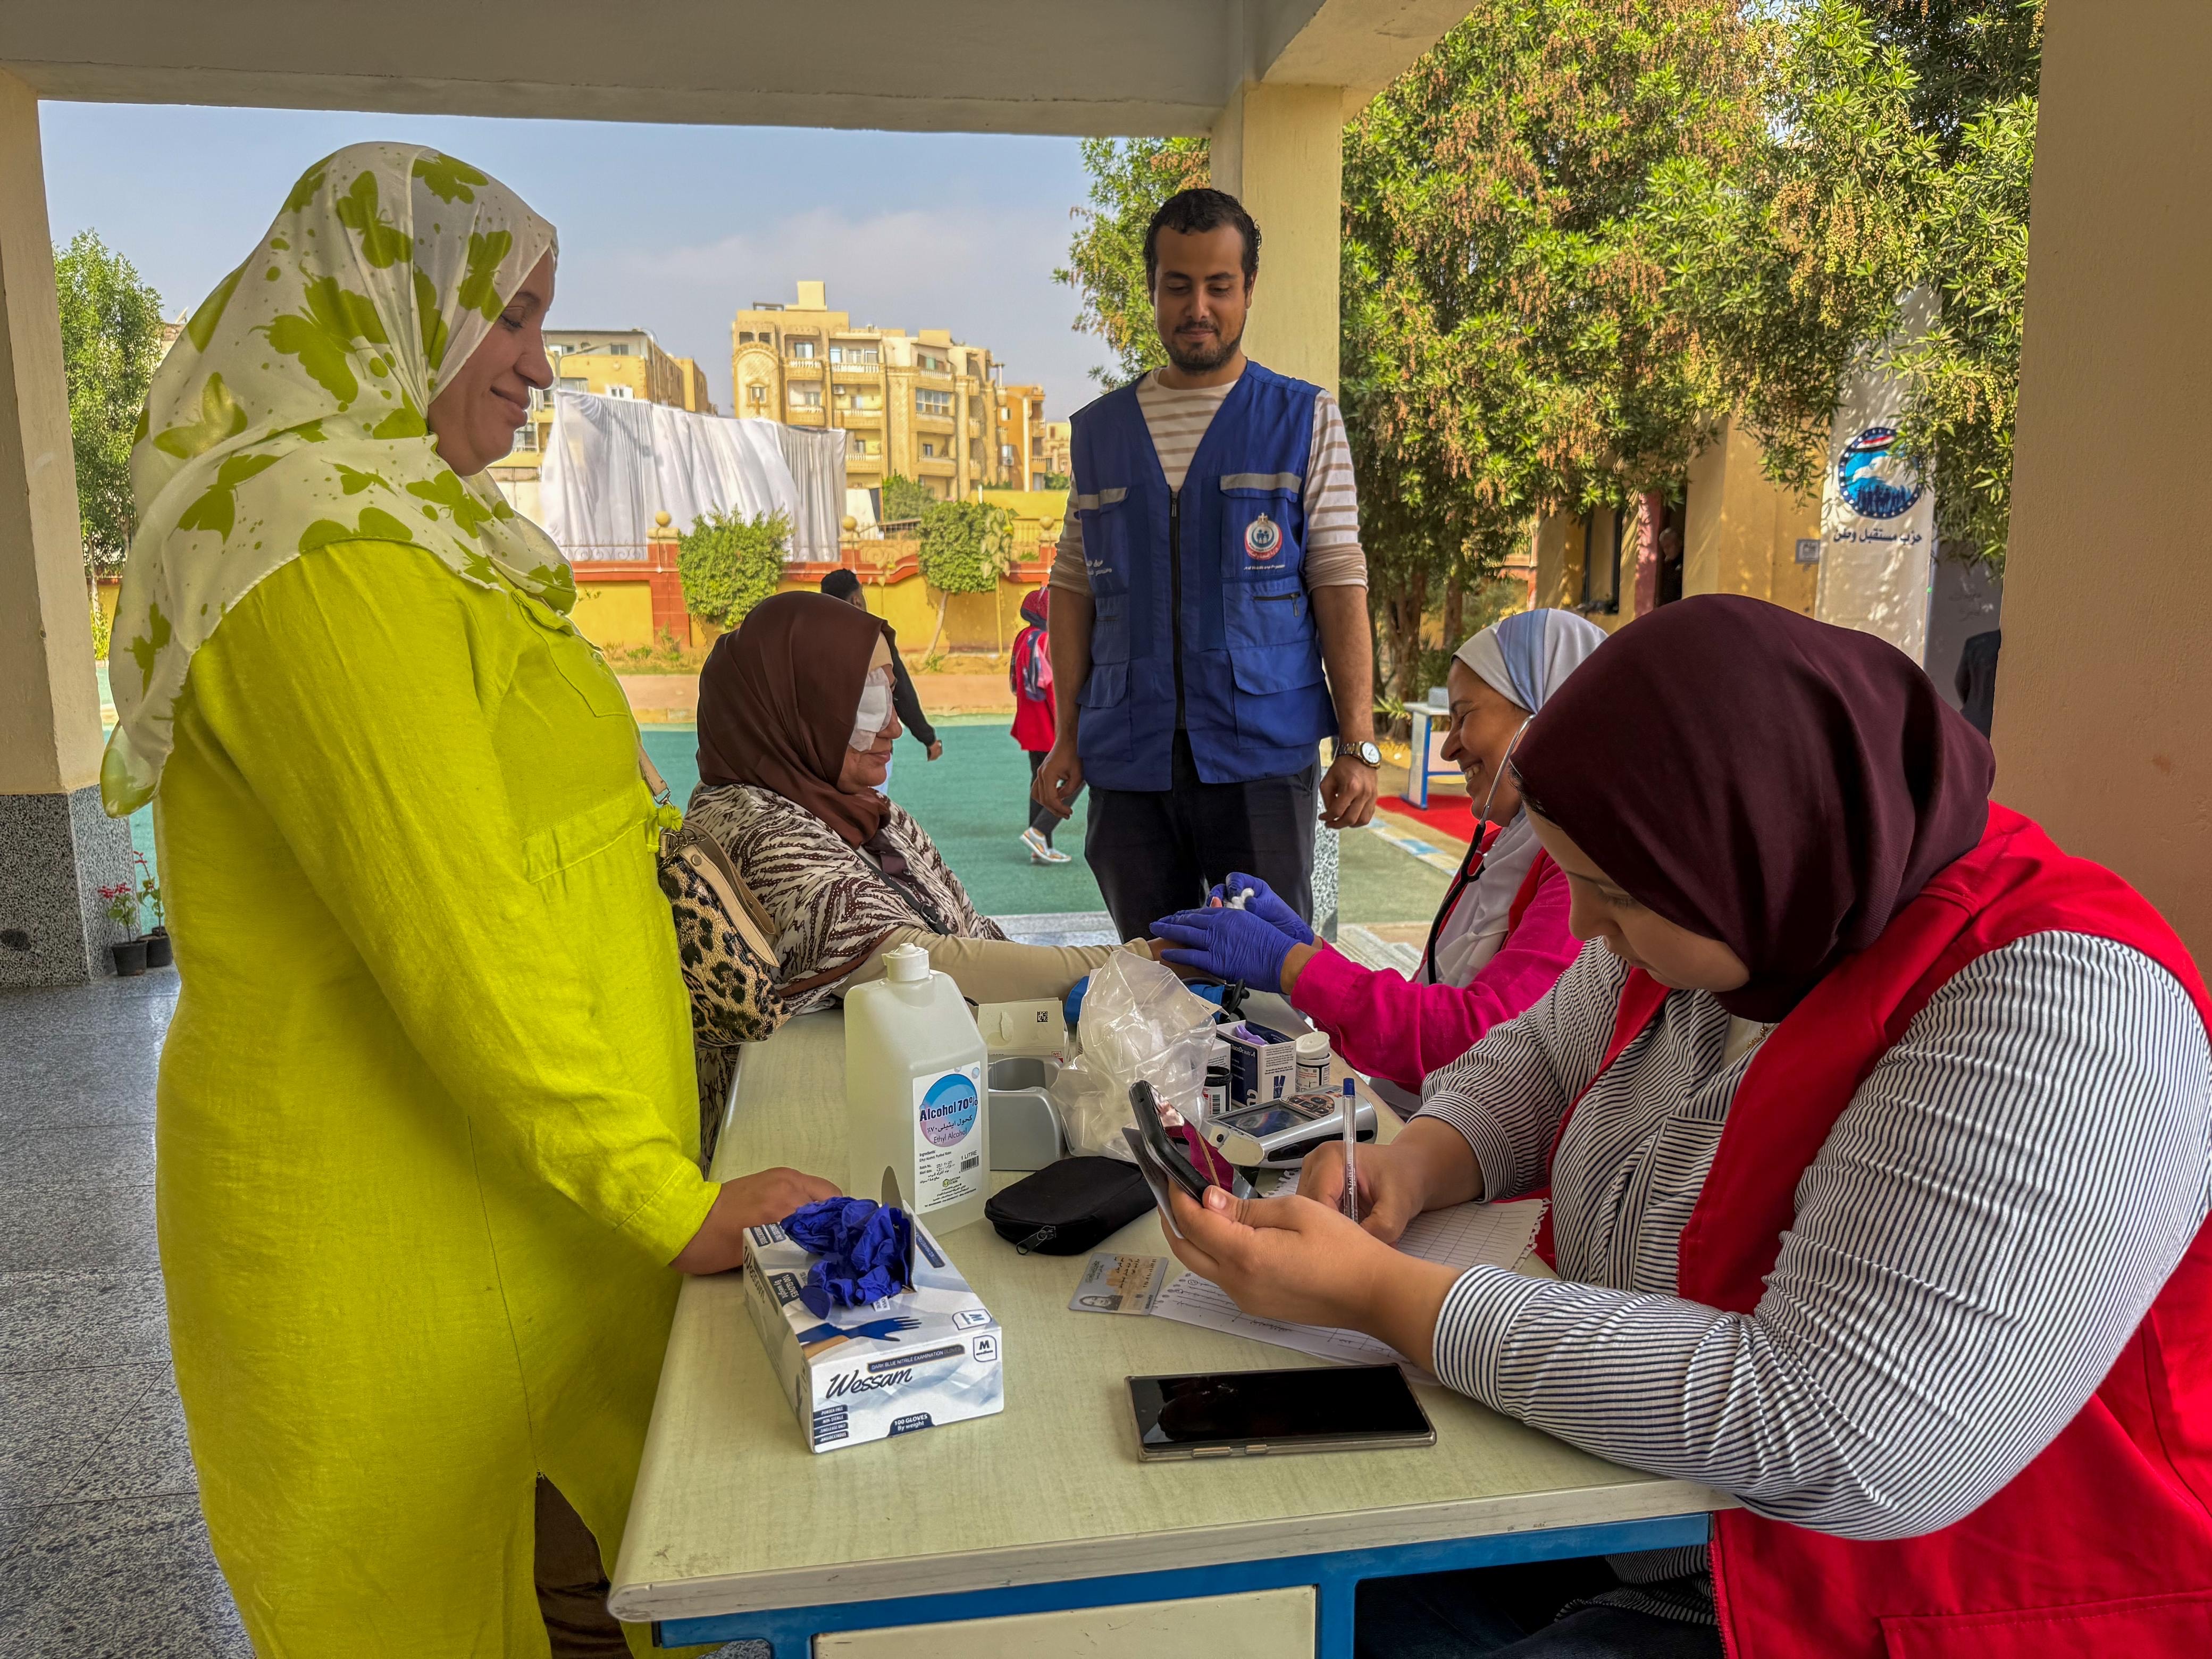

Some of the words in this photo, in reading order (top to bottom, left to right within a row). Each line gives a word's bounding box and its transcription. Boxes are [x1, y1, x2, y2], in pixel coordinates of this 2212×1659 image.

[1833, 528, 1857, 543] وطن
[1859, 527, 1898, 544] مستقبل
[1899, 530, 1922, 546] حزب
[919, 1101, 956, 1122] Alcohol
[957, 1095, 978, 1112] 70%
[957, 1115, 973, 1126] كحول
[934, 1133, 946, 1144] Ethyl
[948, 1127, 968, 1140] Alcohol
[964, 1150, 978, 1159] LITRE
[782, 1274, 792, 1283] 100
[777, 1285, 789, 1298] weight
[786, 1281, 799, 1298] GLOVES
[969, 1313, 985, 1322] M
[979, 1339, 990, 1350] M
[896, 1356, 914, 1365] NITRILE
[914, 1350, 944, 1361] EXAMINATION
[825, 1368, 913, 1400] Wessam
[905, 1414, 928, 1423] GLOVES
[905, 1420, 924, 1429] weight
